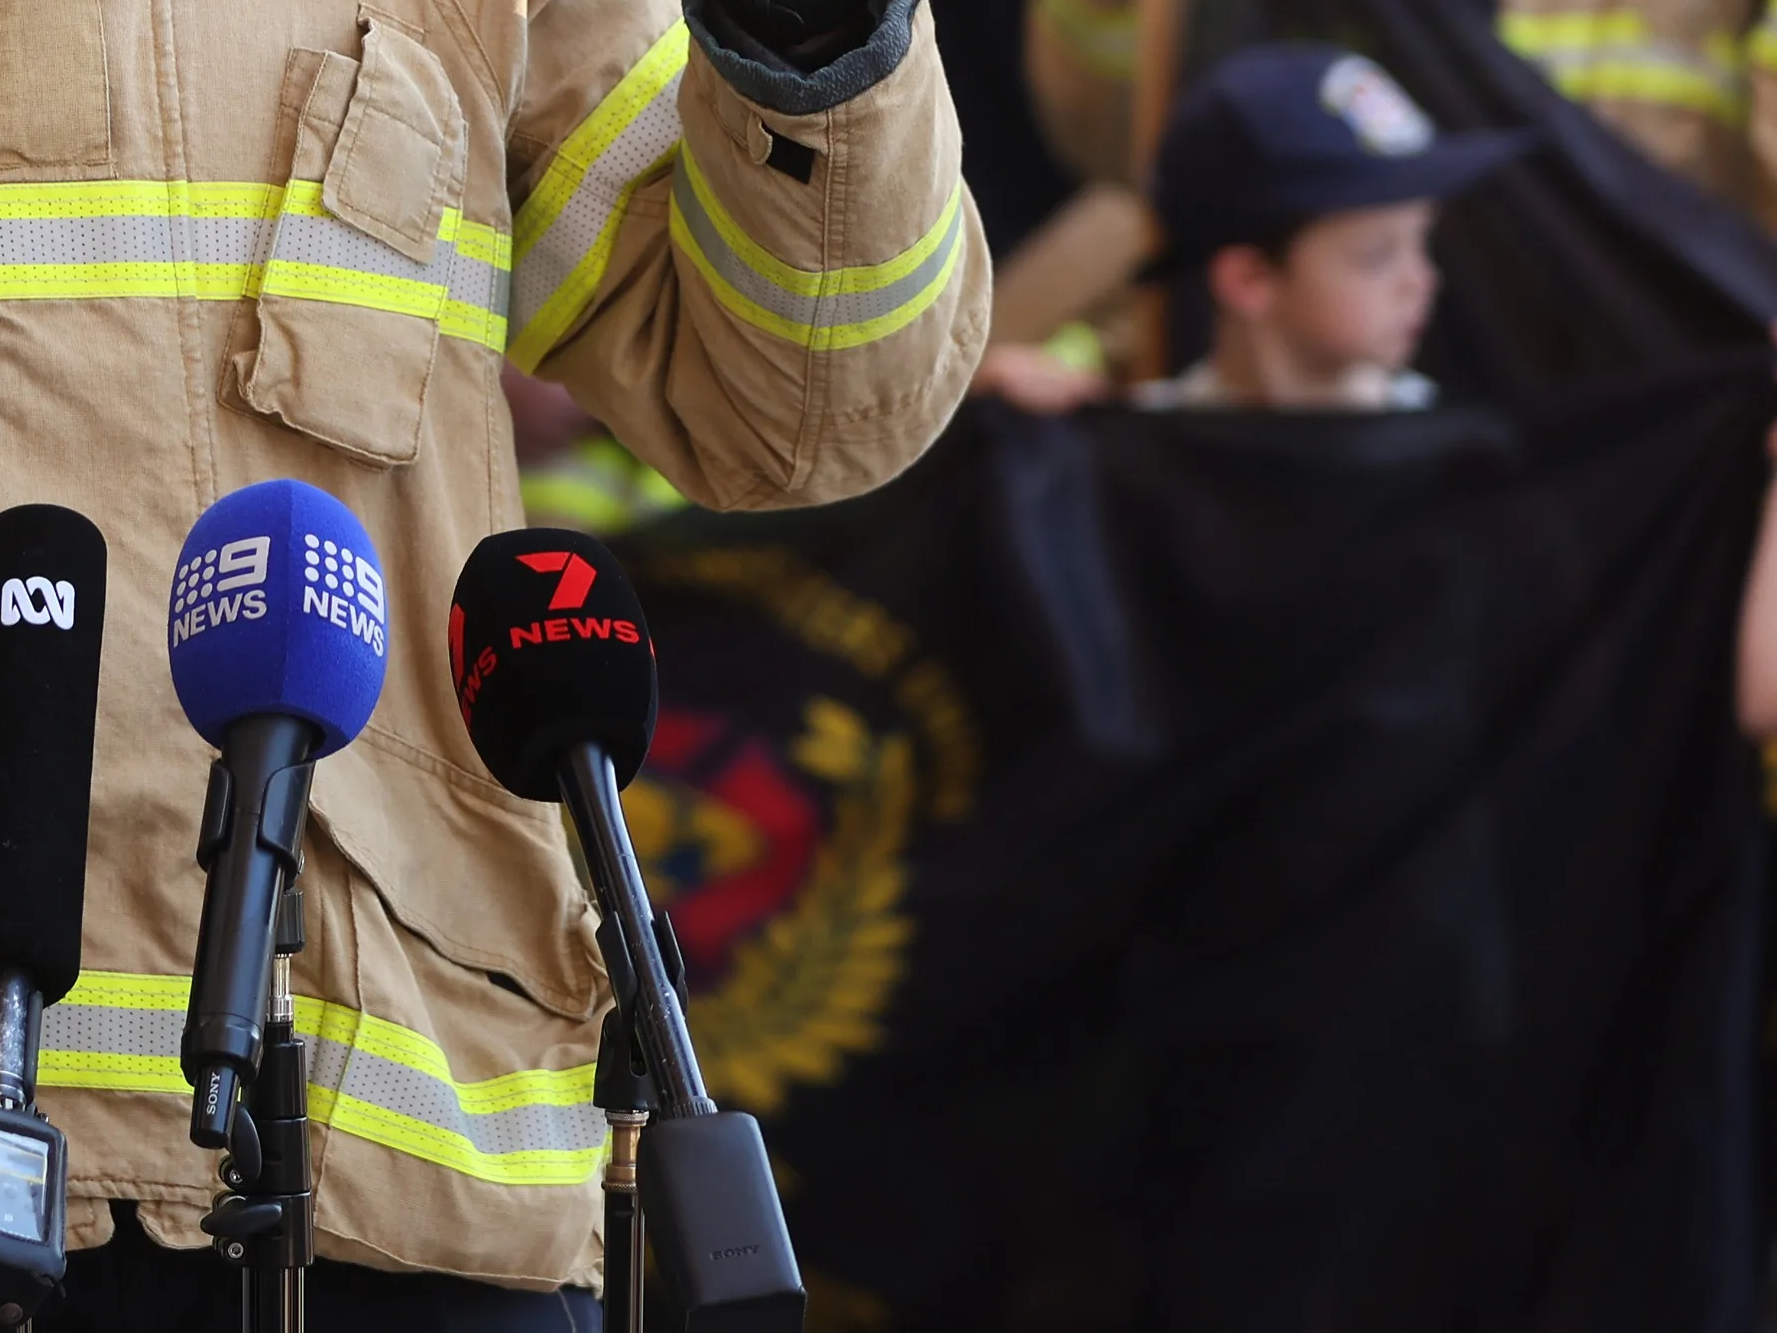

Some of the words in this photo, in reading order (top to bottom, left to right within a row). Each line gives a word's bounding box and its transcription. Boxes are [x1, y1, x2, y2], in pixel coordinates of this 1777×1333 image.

[514, 551, 597, 610] 7
[172, 589, 268, 648] NEWS
[303, 585, 385, 657] NEWS
[509, 617, 640, 649] NEWS
[206, 1071, 221, 1115] SONY
[709, 1245, 760, 1262] SONY
